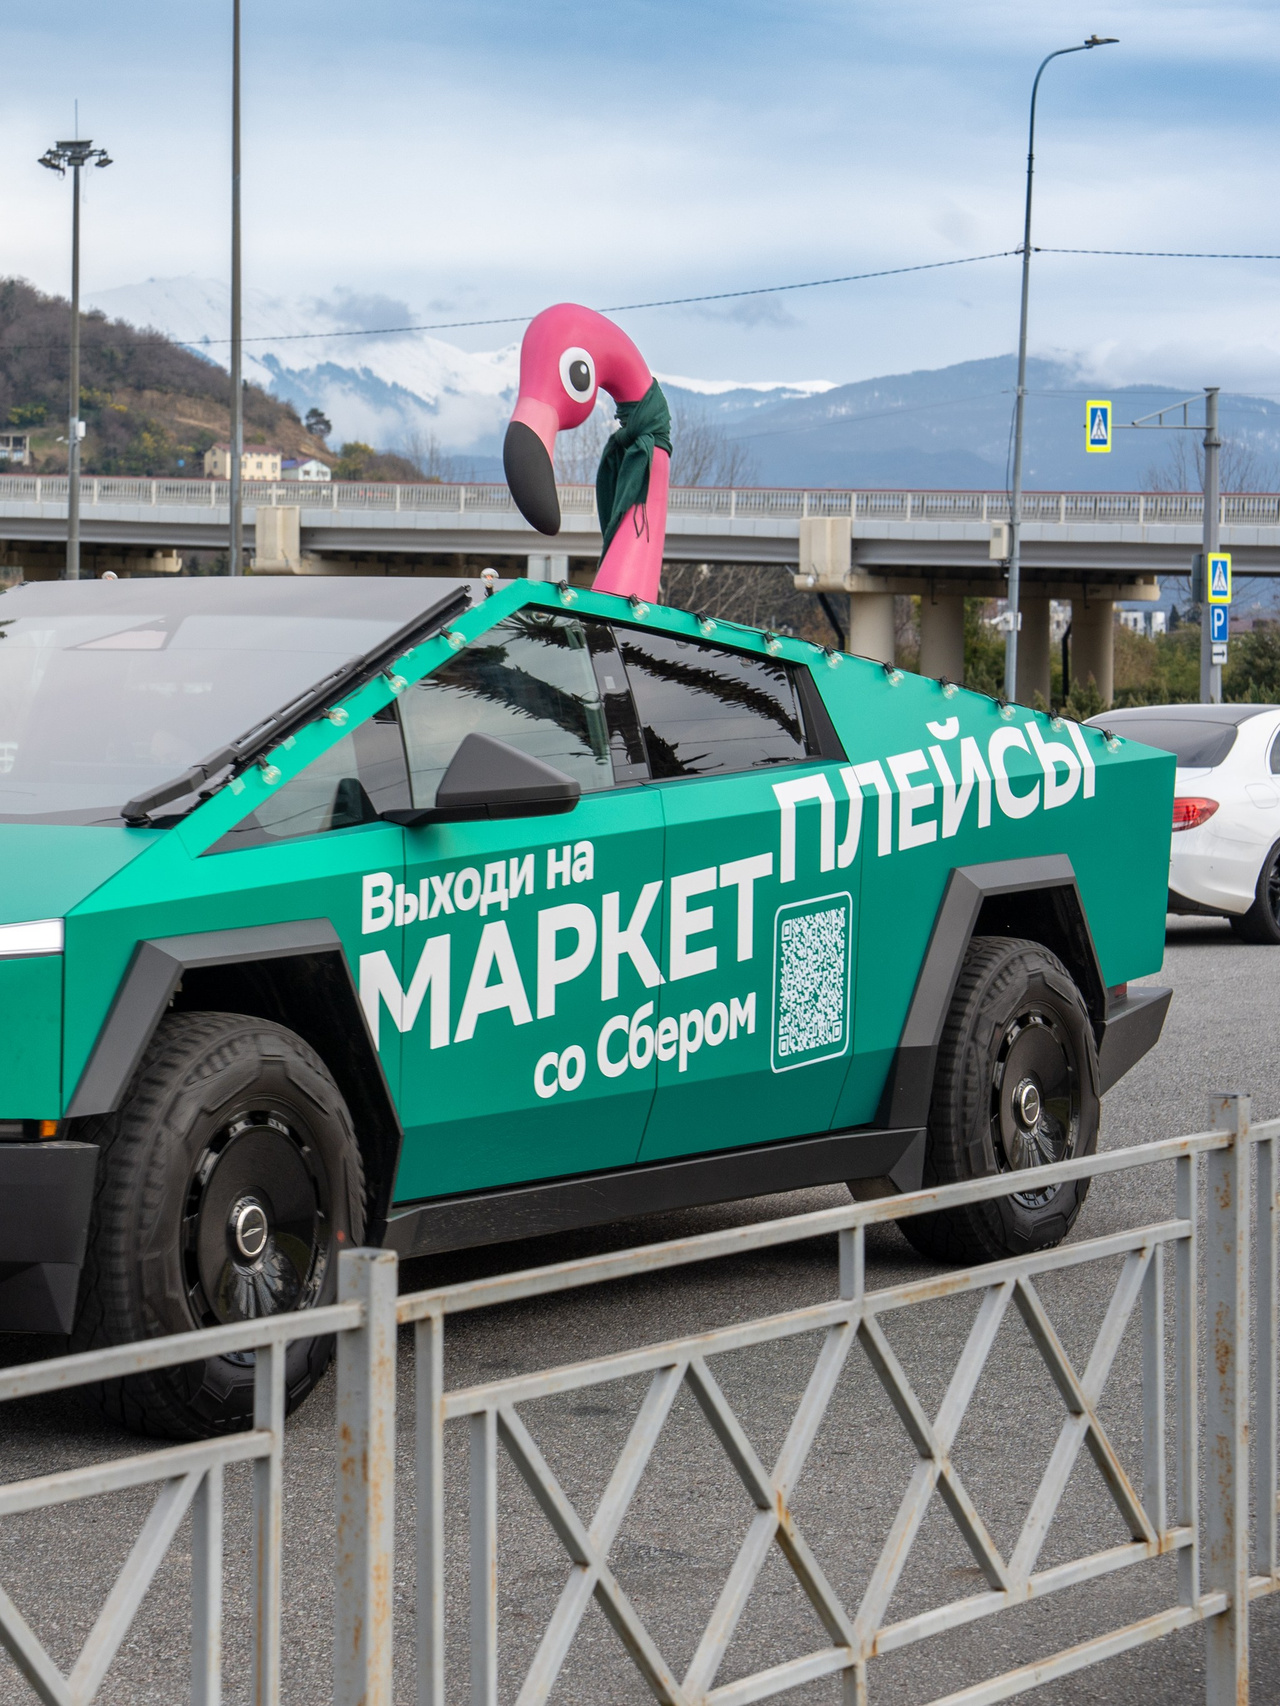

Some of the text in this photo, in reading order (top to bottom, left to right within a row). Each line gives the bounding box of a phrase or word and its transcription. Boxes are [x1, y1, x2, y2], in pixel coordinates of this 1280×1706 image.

[1213, 608, 1225, 638] P
[771, 716, 1096, 884] ПЛЕЙСЫ
[361, 840, 596, 935] Выходи на
[358, 852, 773, 1052] МАРКЕТ
[533, 992, 757, 1099] со Сбером
